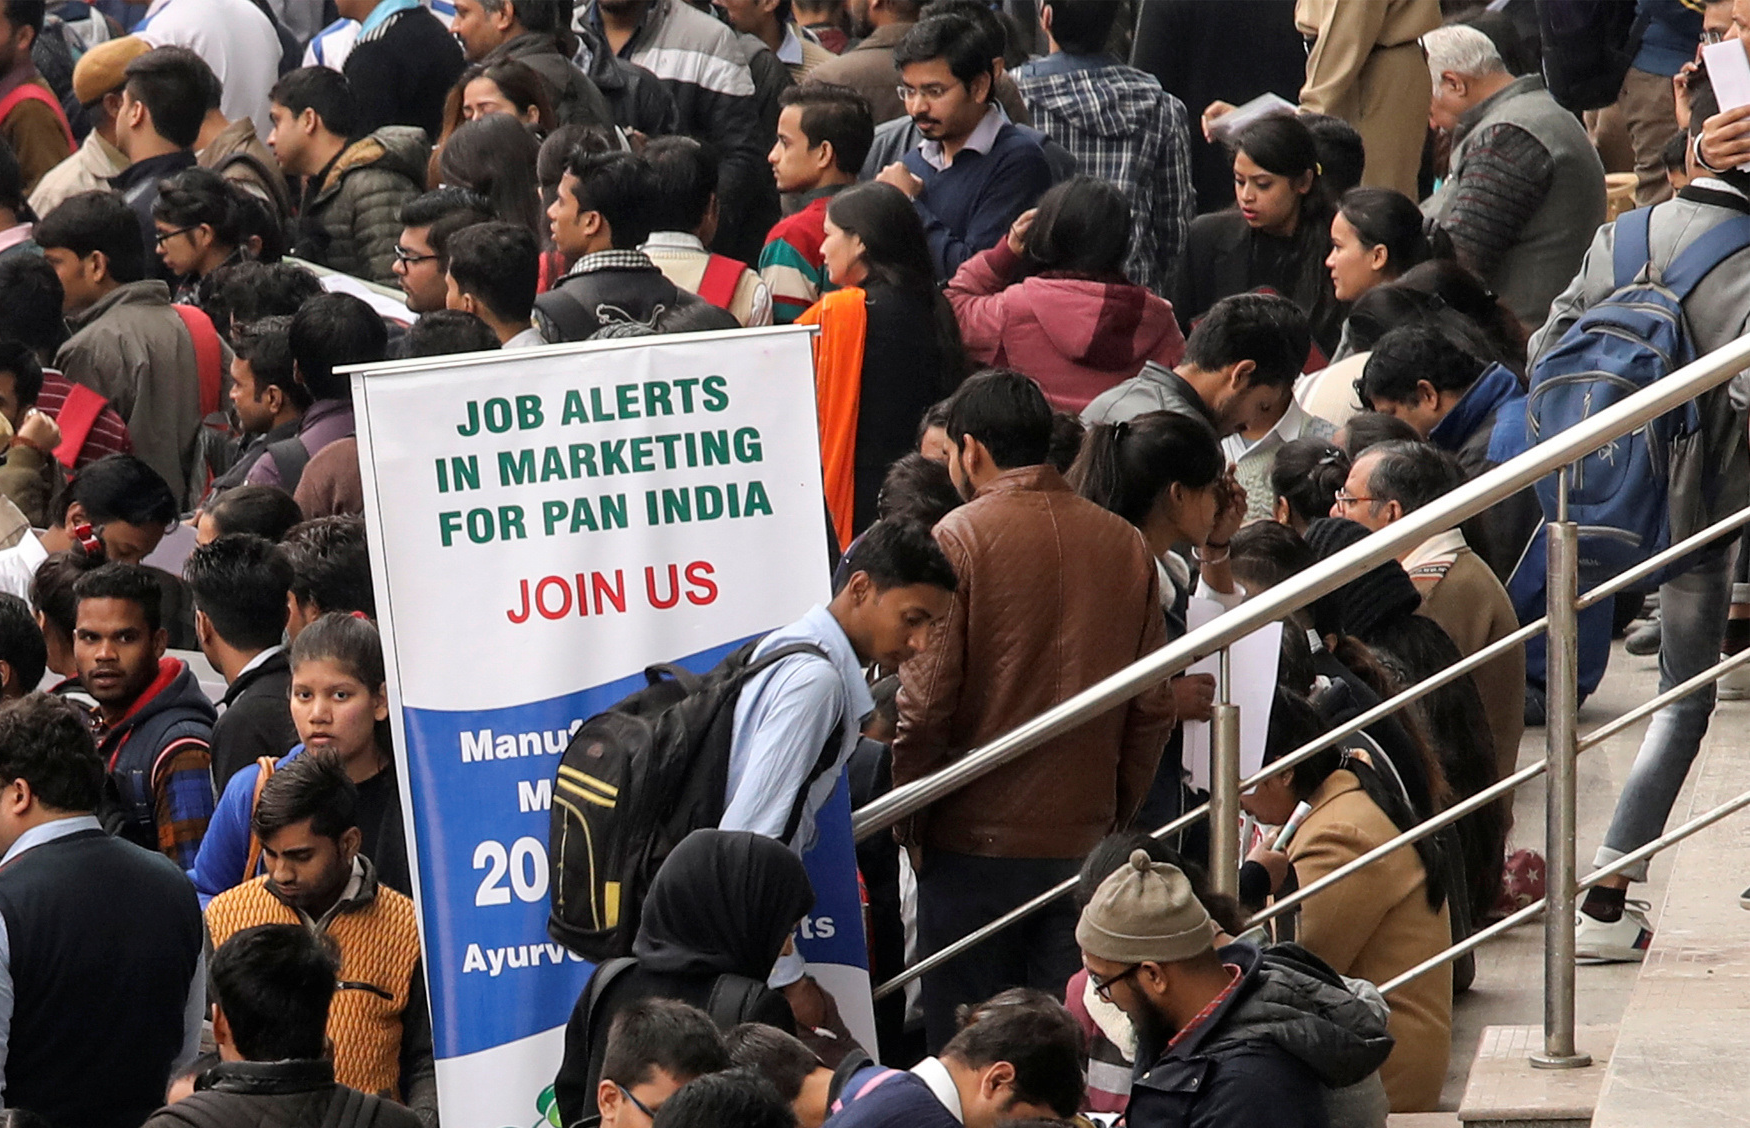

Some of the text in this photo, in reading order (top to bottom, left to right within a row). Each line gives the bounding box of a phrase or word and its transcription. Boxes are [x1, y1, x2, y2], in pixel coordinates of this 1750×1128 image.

[456, 374, 730, 438] JOB ALERTS
[434, 426, 764, 494] IN MARKETING
[438, 480, 774, 548] FOR PAN INDIA
[506, 560, 720, 625] JOIN US
[517, 778, 552, 813] M
[472, 836, 550, 907] 20
[800, 914, 836, 939] ts
